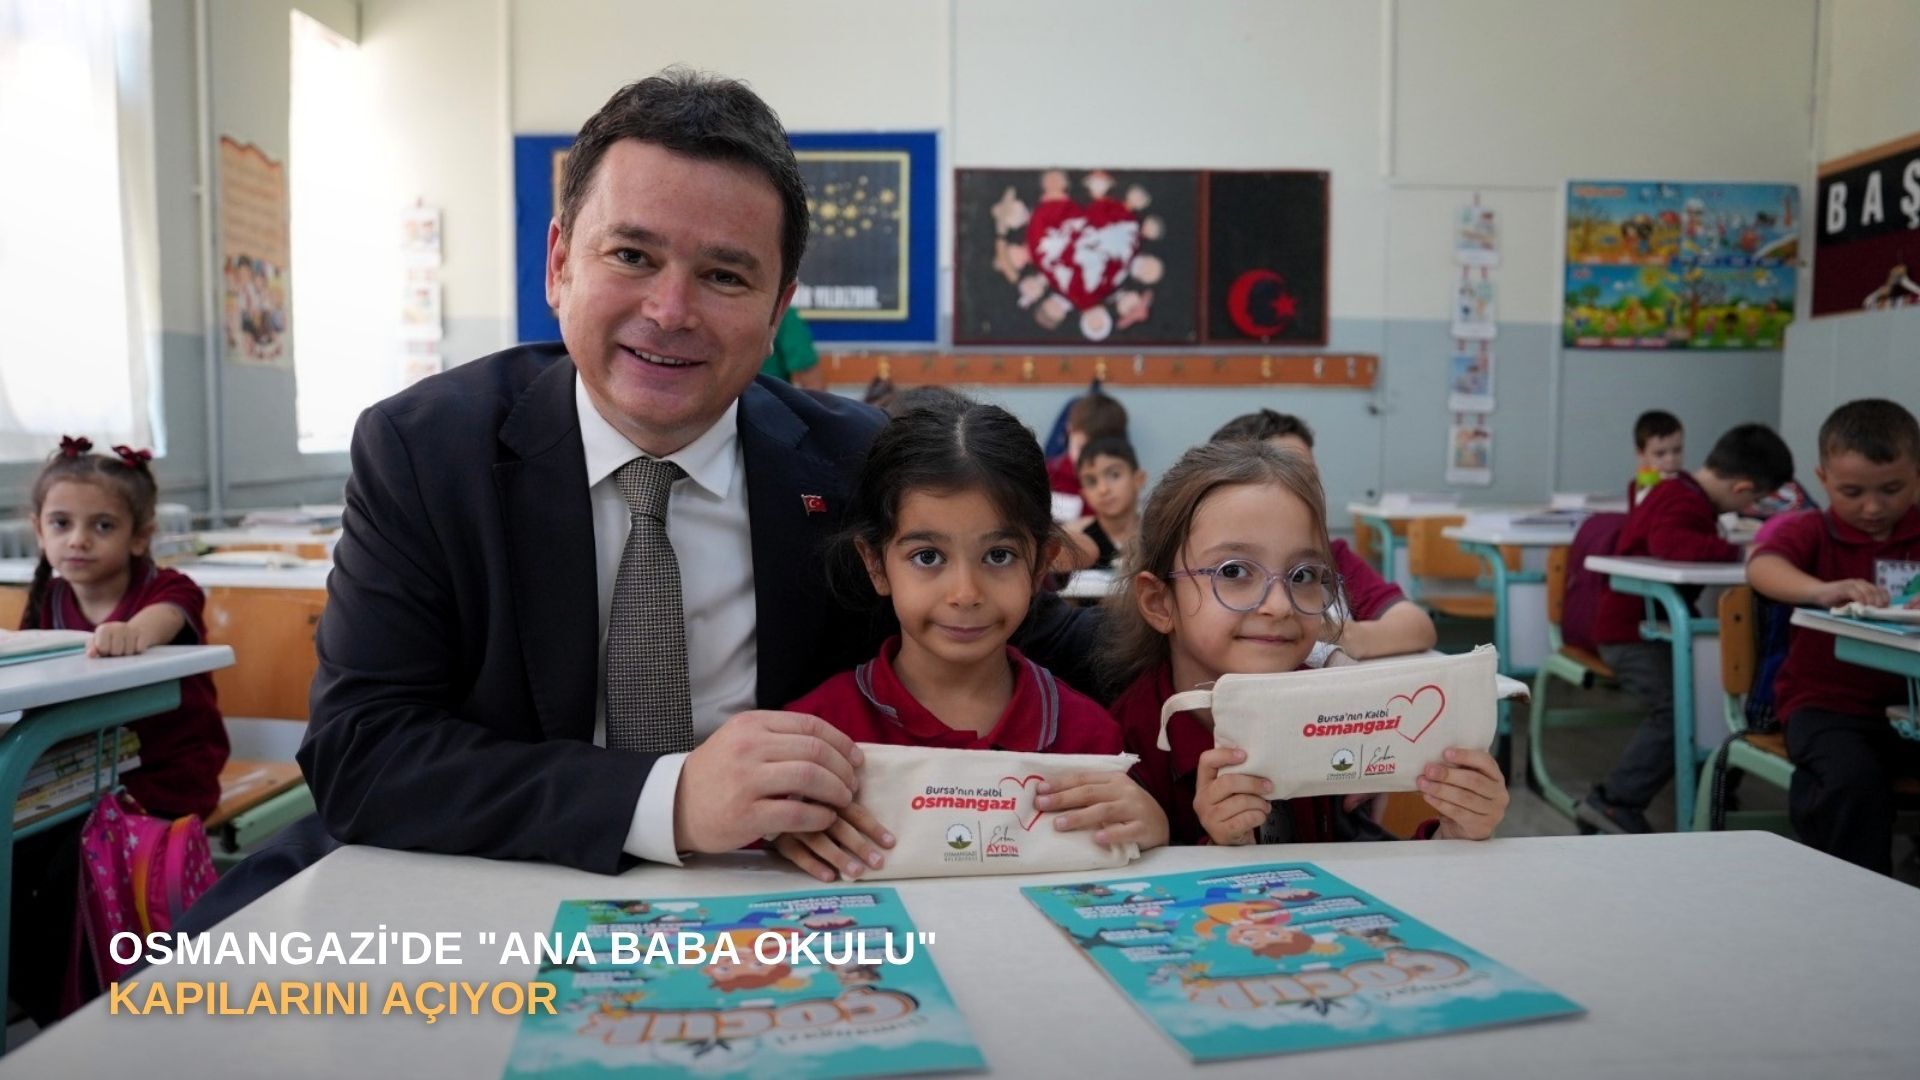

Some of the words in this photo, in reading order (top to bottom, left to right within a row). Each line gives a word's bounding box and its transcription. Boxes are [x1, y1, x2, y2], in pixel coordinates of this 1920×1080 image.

[1317, 712, 1363, 723] Bursa'nın
[1365, 709, 1389, 719] Kalbi
[1302, 715, 1402, 737] Osmangazi
[1364, 762, 1396, 773] AYDIN
[925, 786, 974, 796] Bursa'nın
[976, 787, 1002, 797] Kalbi
[911, 796, 1016, 811] Osmangazi
[986, 844, 1018, 853] AYDIN
